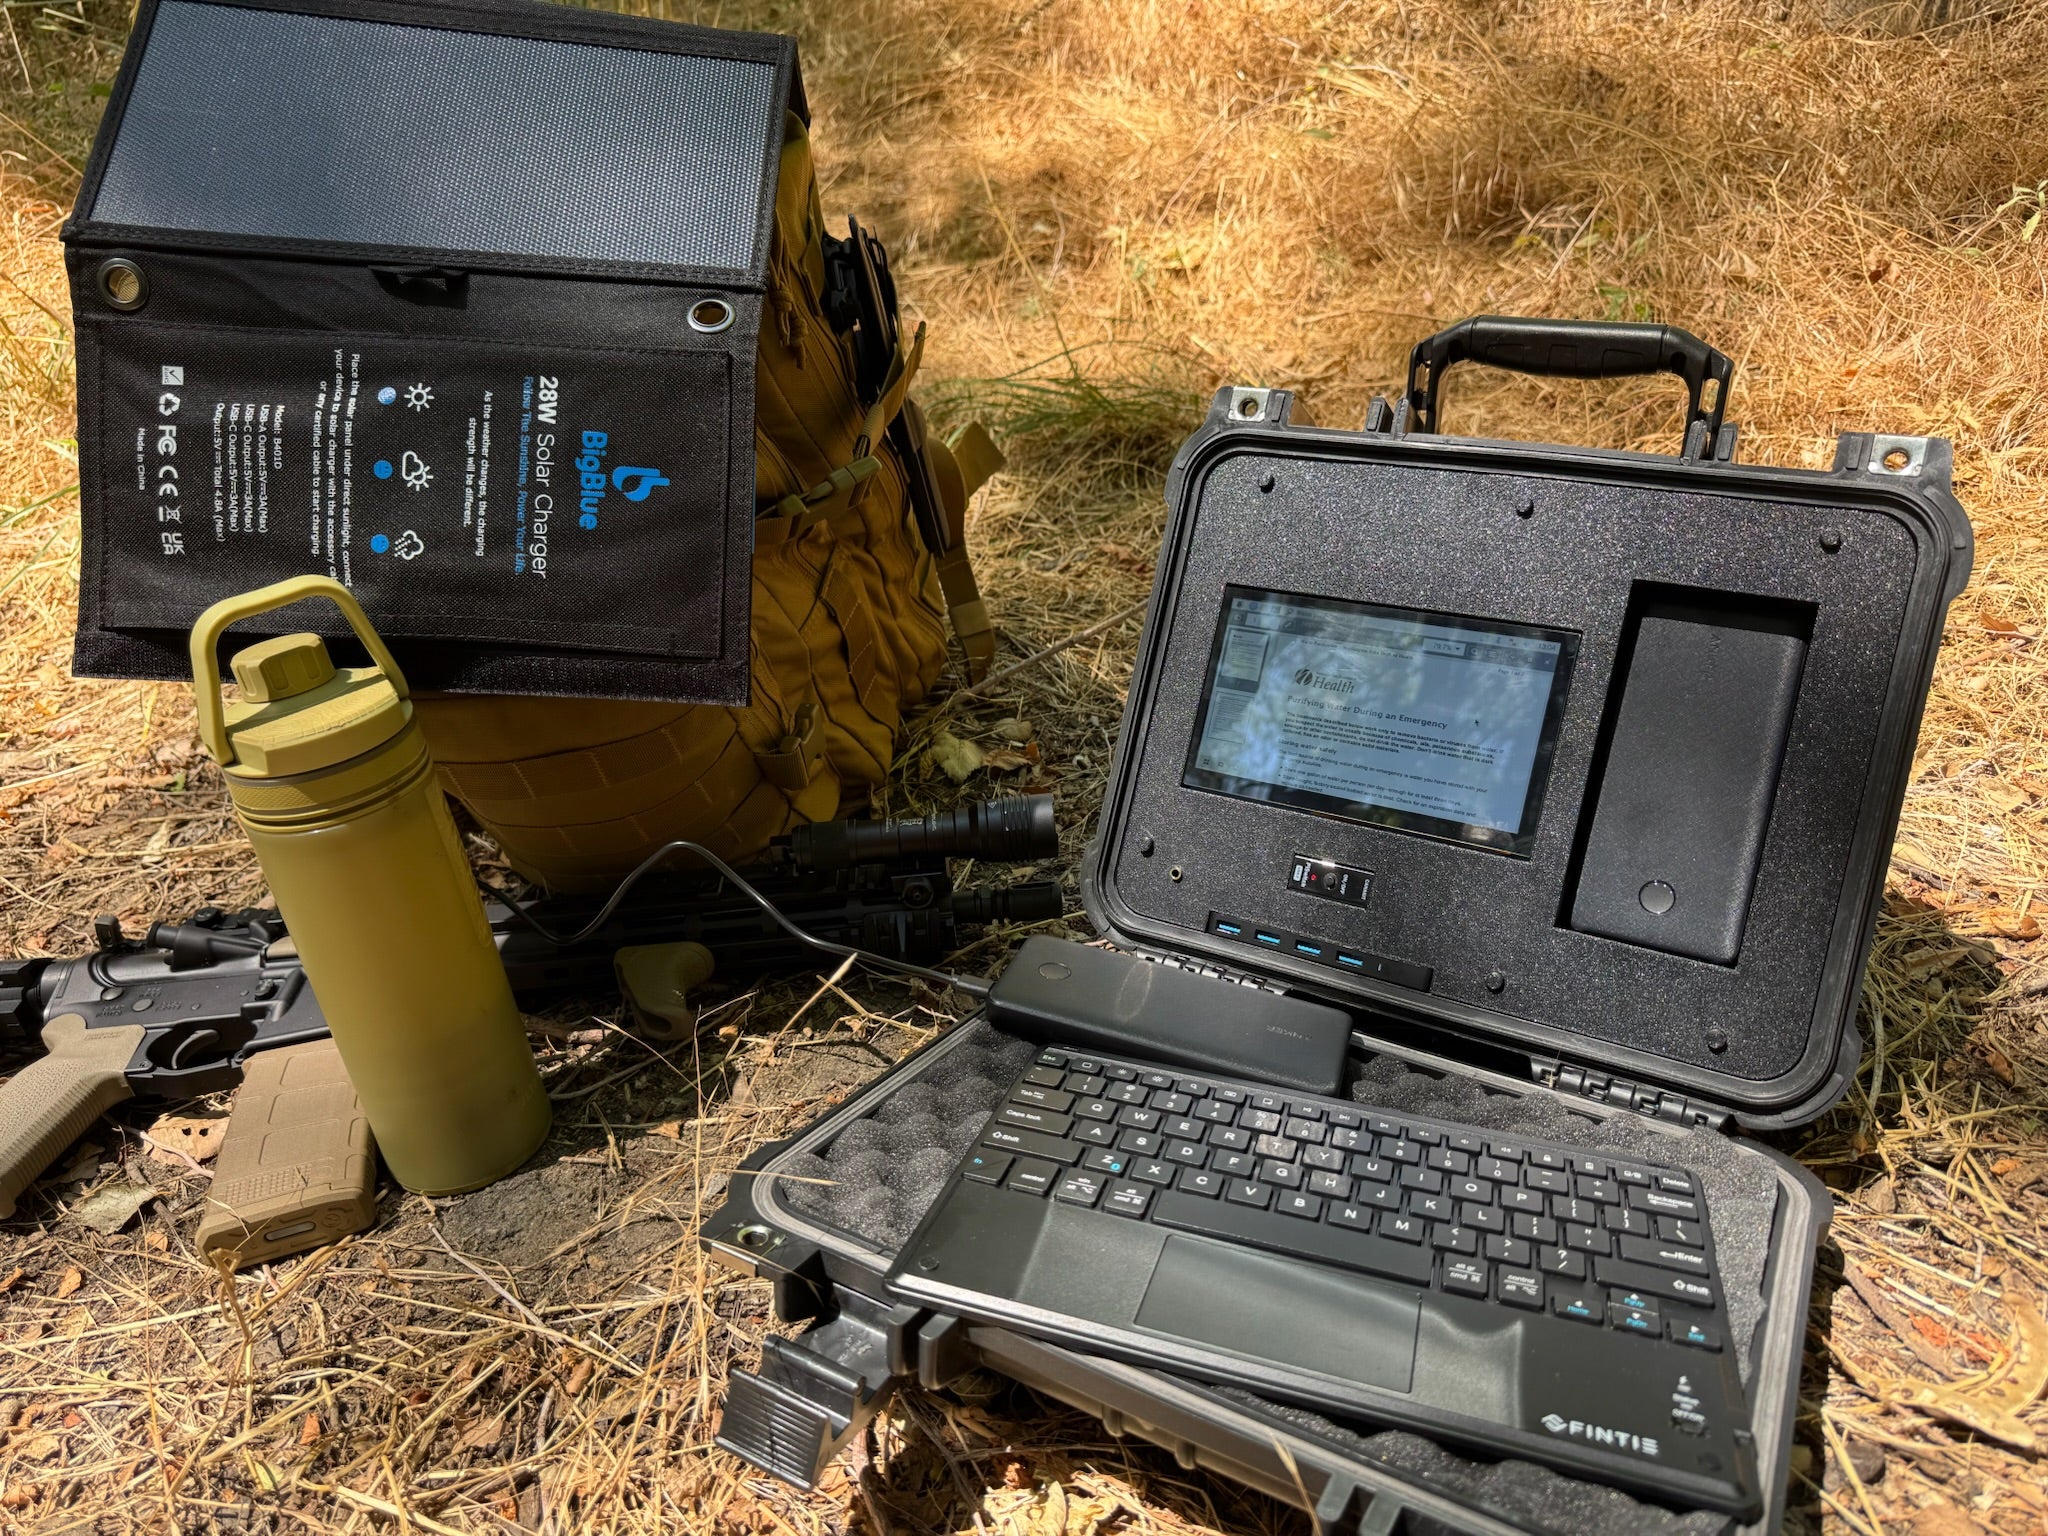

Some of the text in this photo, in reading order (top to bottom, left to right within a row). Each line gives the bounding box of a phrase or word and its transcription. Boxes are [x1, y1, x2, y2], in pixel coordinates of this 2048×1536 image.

[334, 349, 343, 370] your
[320, 381, 327, 391] or
[334, 373, 344, 401] device
[522, 376, 533, 409] Follow
[315, 393, 326, 409] any
[332, 403, 341, 412] to
[229, 403, 241, 432] USB-C
[244, 404, 255, 432] USB-C
[259, 404, 270, 432] USB-A
[521, 411, 532, 432] The
[313, 410, 322, 447] certified
[329, 415, 338, 437] solar
[137, 427, 146, 452] Made
[274, 405, 285, 469] Model: B401D
[313, 450, 321, 475] cable
[327, 439, 337, 475] charger
[517, 434, 530, 488] Sunshine,
[137, 464, 146, 490] China
[214, 465, 223, 488] Total
[341, 354, 360, 587] Place the solar panel under direct sunlight, connect
[463, 417, 477, 527] strength will be different.
[475, 390, 493, 556] As the weather changes, the charging
[530, 375, 559, 579] 28W Solar Charger
[313, 477, 320, 487] to
[328, 477, 336, 498] with
[575, 430, 608, 530] BigBlue
[214, 489, 223, 512] 4.8A
[516, 491, 528, 524] Power
[328, 501, 336, 516] the
[213, 515, 226, 542] (Max)
[311, 514, 320, 557] charging.
[327, 518, 335, 563] accessory
[515, 526, 526, 551] Your
[1312, 675, 1355, 694] Health
[1352, 706, 1383, 719] During
[1384, 712, 1397, 720] an
[1397, 713, 1448, 731] Emergency
[1006, 1109, 1041, 1121] Caps lock
[1091, 1103, 1103, 1112] Q
[1134, 1112, 1148, 1121] W
[1090, 1128, 1101, 1136] A
[1180, 1122, 1189, 1131] E
[1002, 1134, 1020, 1142] Shift
[1136, 1137, 1147, 1145] S
[1224, 1132, 1236, 1141] R
[1181, 1147, 1193, 1156] D
[1272, 1141, 1282, 1150] T
[1101, 1155, 1114, 1164] Z
[1229, 1157, 1239, 1166] F
[1320, 1151, 1330, 1160] Y
[1148, 1165, 1161, 1174] X
[1276, 1168, 1288, 1177] G
[1367, 1162, 1378, 1171] U
[1196, 1176, 1208, 1185] C
[1324, 1178, 1336, 1188] H
[1465, 1183, 1477, 1192] O
[1663, 1177, 1689, 1188] Delete
[1245, 1186, 1257, 1196] V
[1376, 1189, 1385, 1198] J
[1516, 1192, 1527, 1202] P
[1294, 1198, 1305, 1208] B
[1425, 1200, 1436, 1209] K
[1345, 1209, 1357, 1219] N
[1478, 1211, 1488, 1221] L
[1395, 1220, 1409, 1231] M
[1686, 1284, 1709, 1296] Shift
[1568, 1419, 1659, 1456] FINTIE
